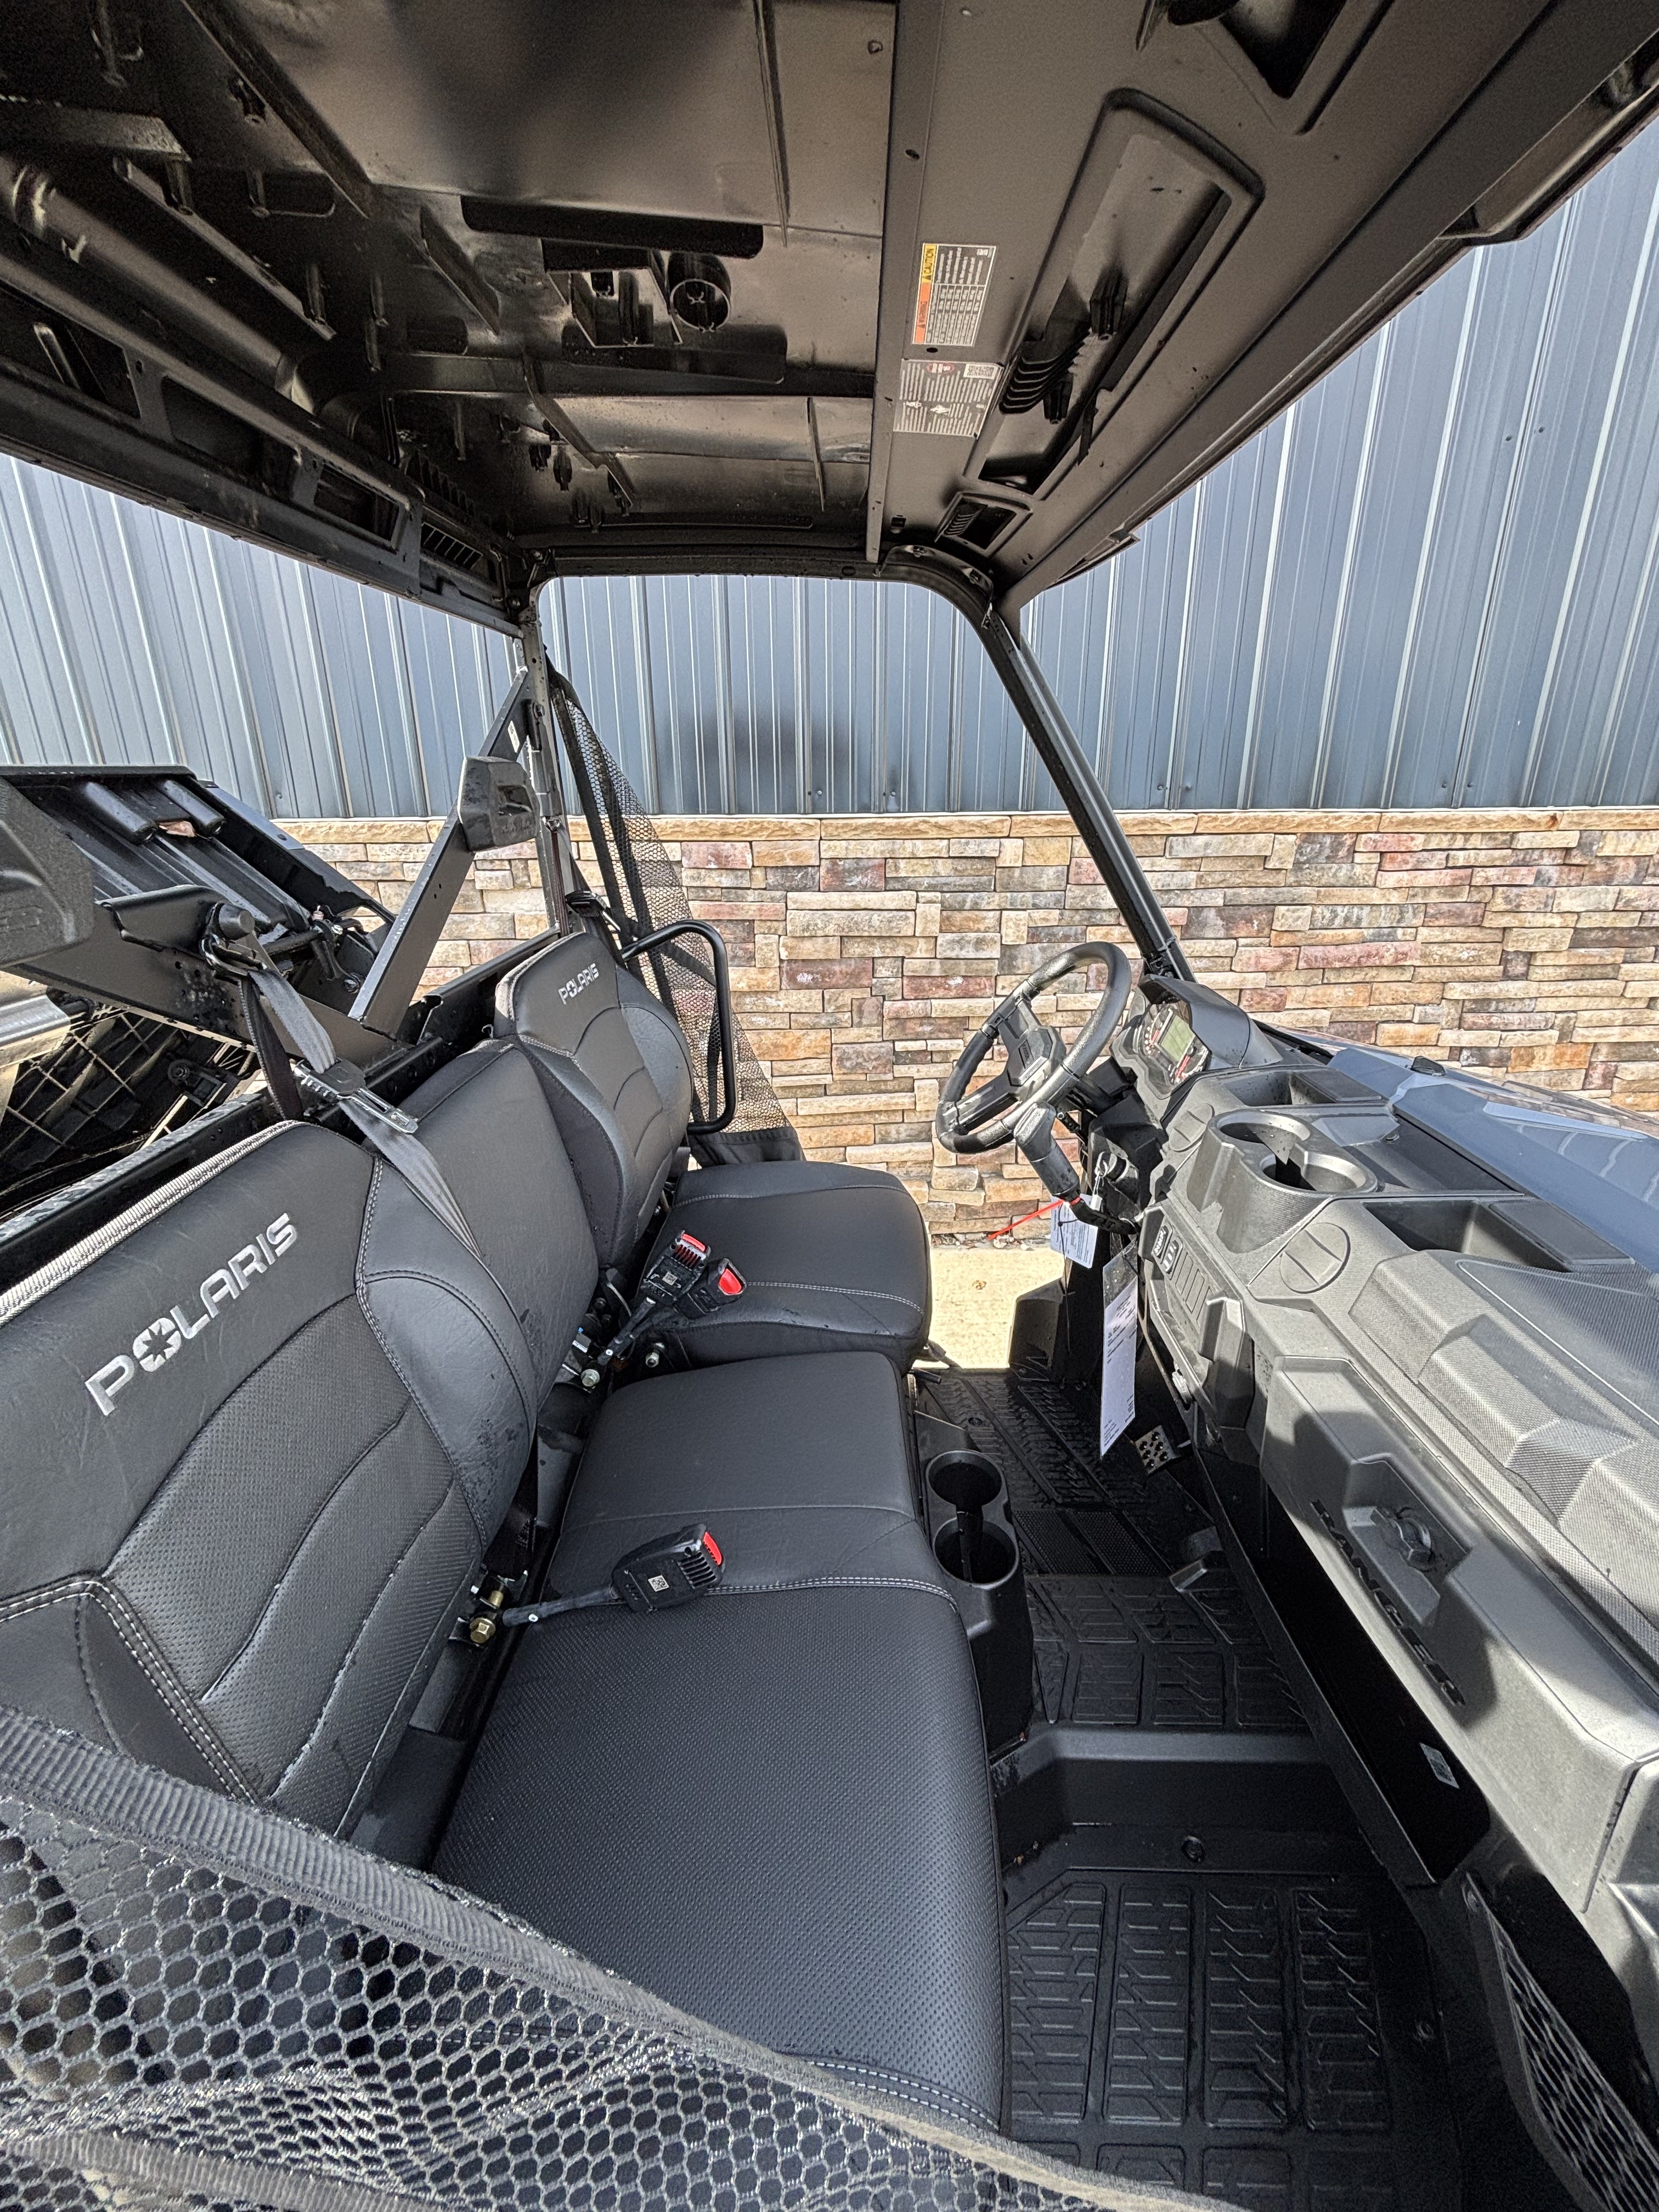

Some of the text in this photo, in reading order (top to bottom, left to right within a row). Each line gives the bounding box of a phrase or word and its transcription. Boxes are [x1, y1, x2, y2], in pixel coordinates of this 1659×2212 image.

[558, 963, 599, 1005] POLARIS
[86, 1212, 297, 1416] POLARIS
[1311, 1499, 1466, 1706] RANGER
